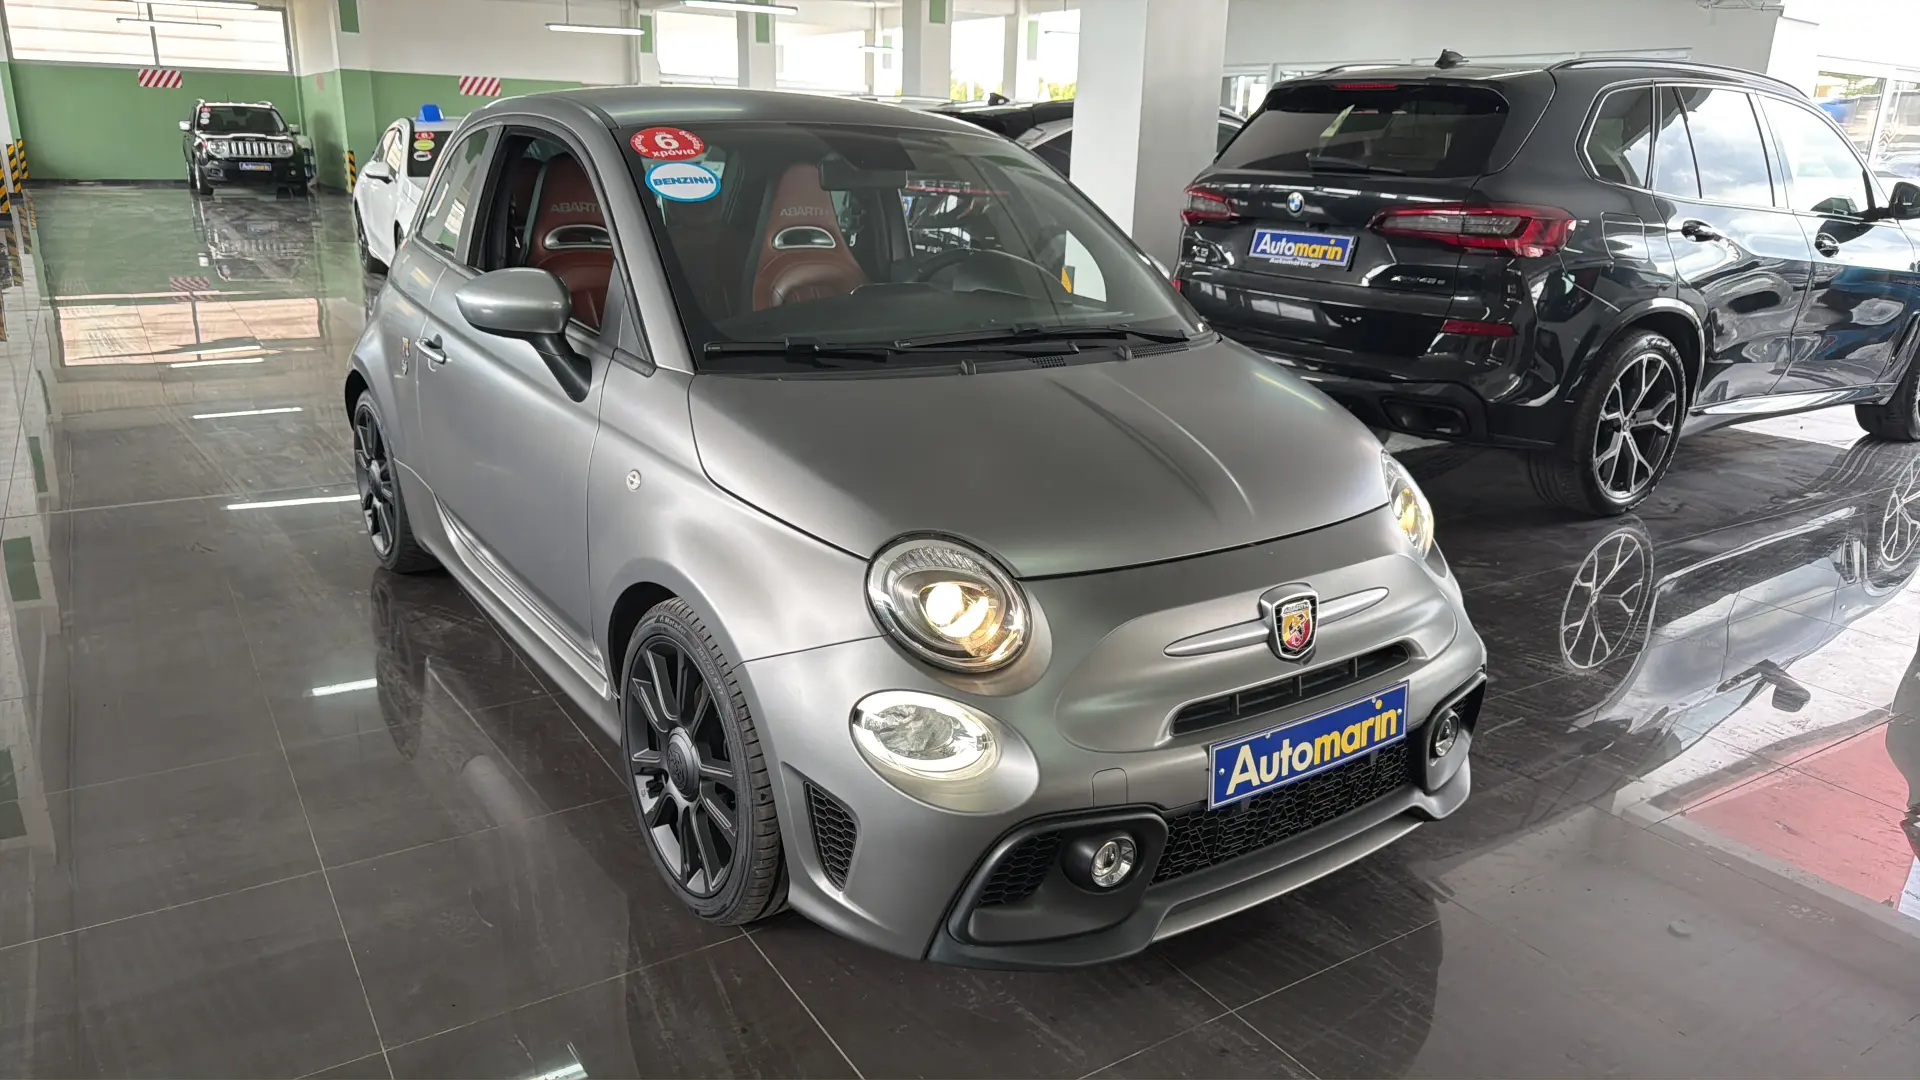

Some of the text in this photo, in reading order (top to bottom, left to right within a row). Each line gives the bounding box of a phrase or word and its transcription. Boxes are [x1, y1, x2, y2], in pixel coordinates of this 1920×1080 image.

[654, 133, 680, 150] 6
[651, 148, 696, 158] χρόνια
[1256, 233, 1343, 261] Automarin
[1225, 699, 1398, 796] Automarin
